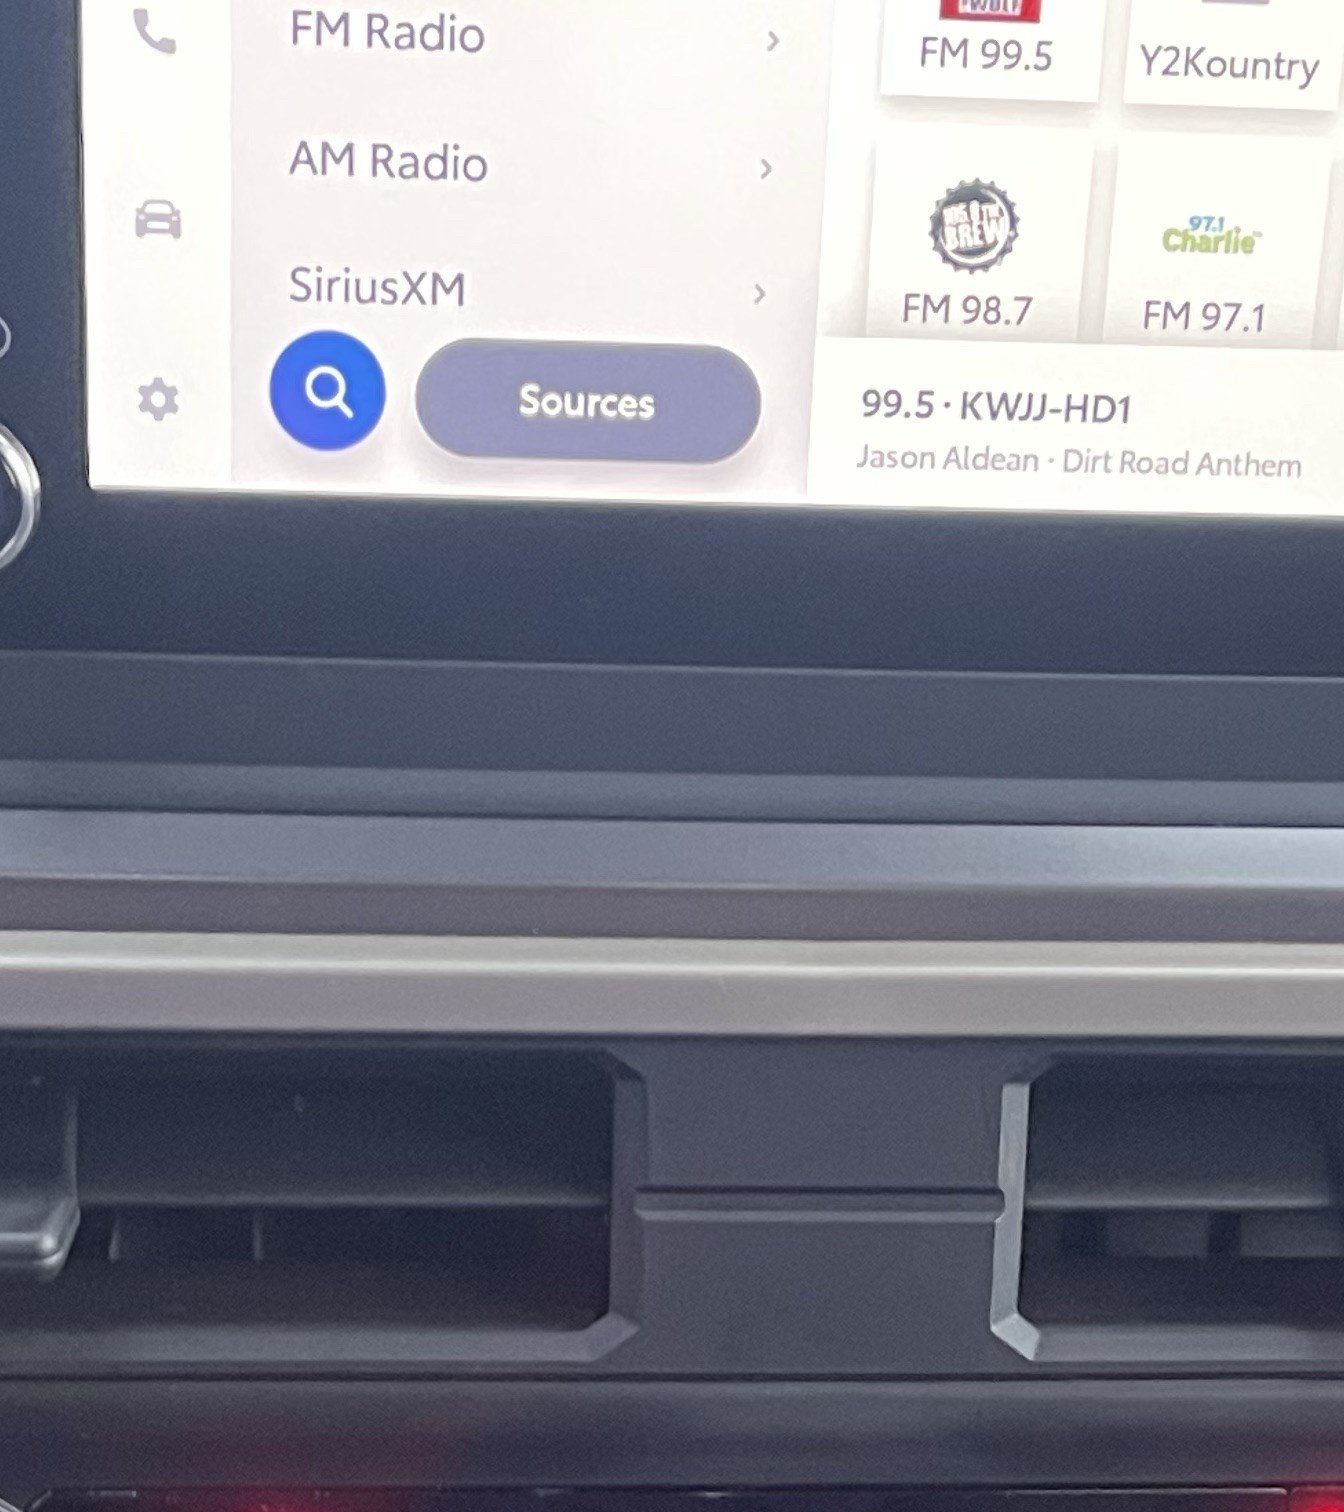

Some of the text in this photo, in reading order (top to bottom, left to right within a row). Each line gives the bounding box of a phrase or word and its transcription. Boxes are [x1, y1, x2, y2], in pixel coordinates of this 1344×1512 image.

[292, 9, 485, 54] FM Radio
[920, 36, 1053, 72] FM 99.5
[1140, 43, 1321, 91] Y2Kountry
[289, 140, 488, 183] AM Radio
[1162, 226, 1256, 254] Charlie
[1189, 214, 1226, 232] 97.1
[289, 265, 465, 307] SiriusXM
[903, 293, 1034, 326] FM 98.7
[1143, 300, 1265, 333] FM 97.1
[519, 383, 655, 420] Sources
[862, 389, 1130, 424] 99.5 KWJJ-HD1
[856, 443, 1302, 479] Jason Aldean Dirt Road Anthem
